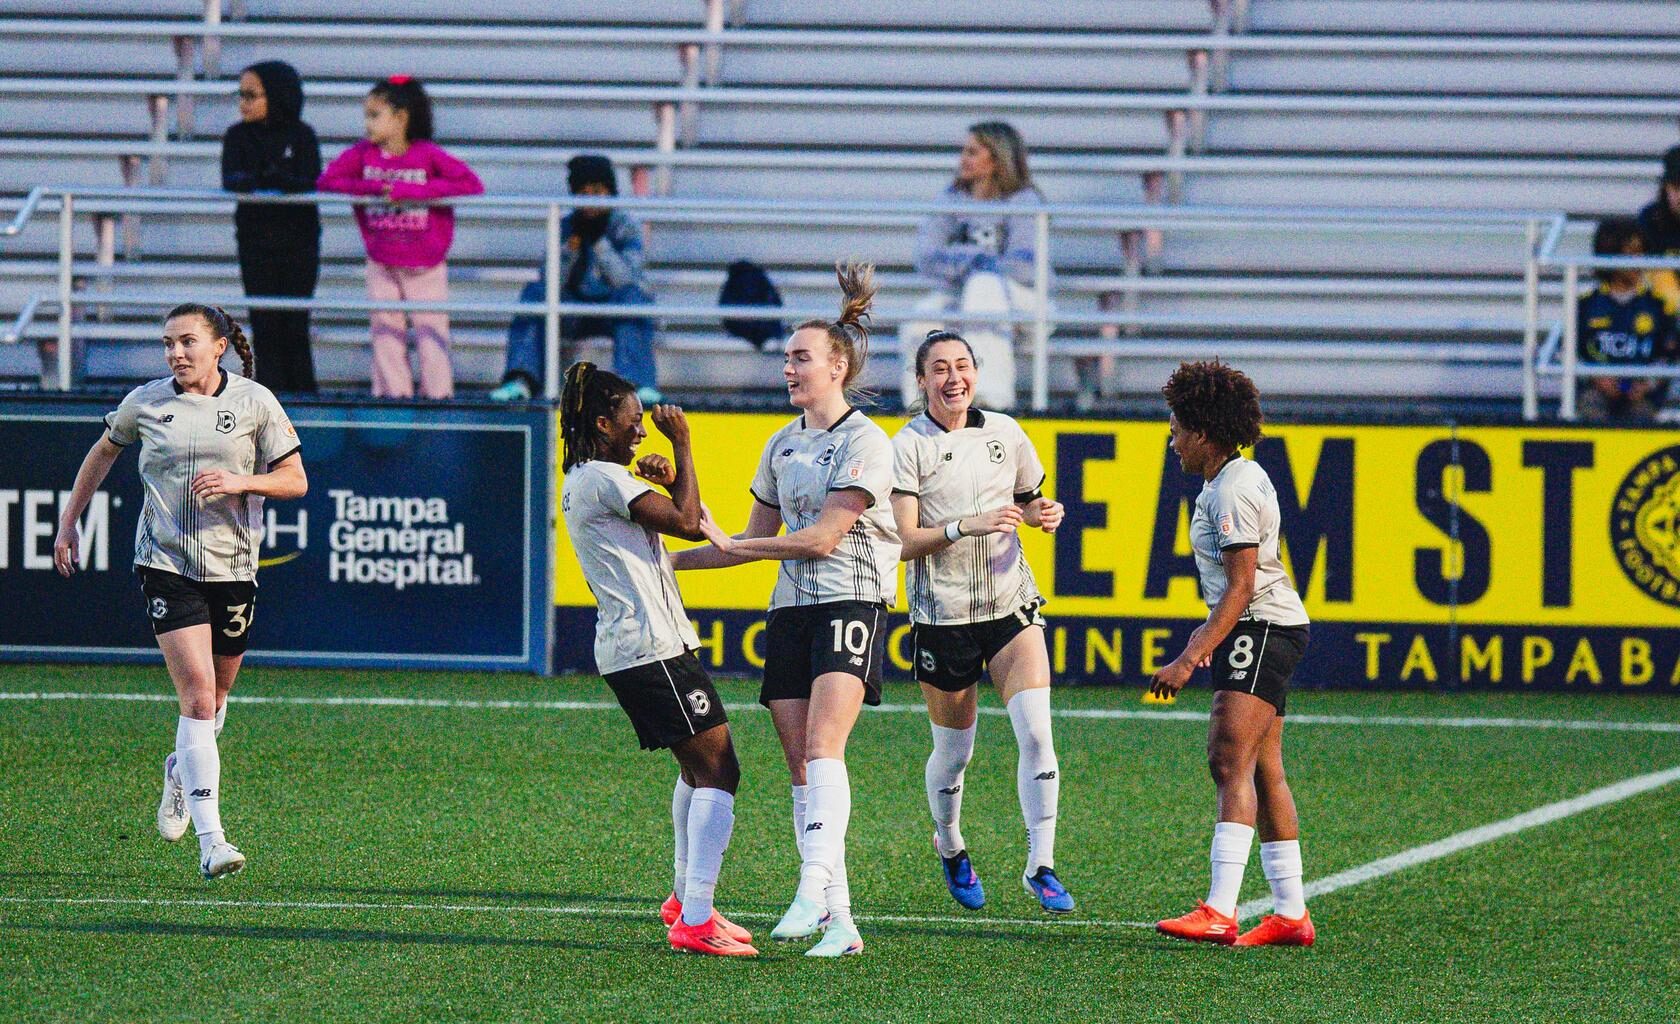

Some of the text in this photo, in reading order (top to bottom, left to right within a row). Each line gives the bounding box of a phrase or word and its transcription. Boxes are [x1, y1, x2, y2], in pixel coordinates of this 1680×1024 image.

[328, 489, 448, 527] Tampa
[1054, 433, 1356, 603] EAM
[328, 520, 464, 554] General
[1617, 538, 1680, 601] FOOTB
[223, 603, 254, 638] 3
[830, 619, 870, 655] 10
[1228, 634, 1254, 669] 8
[1354, 632, 1680, 686] TAMPAB
